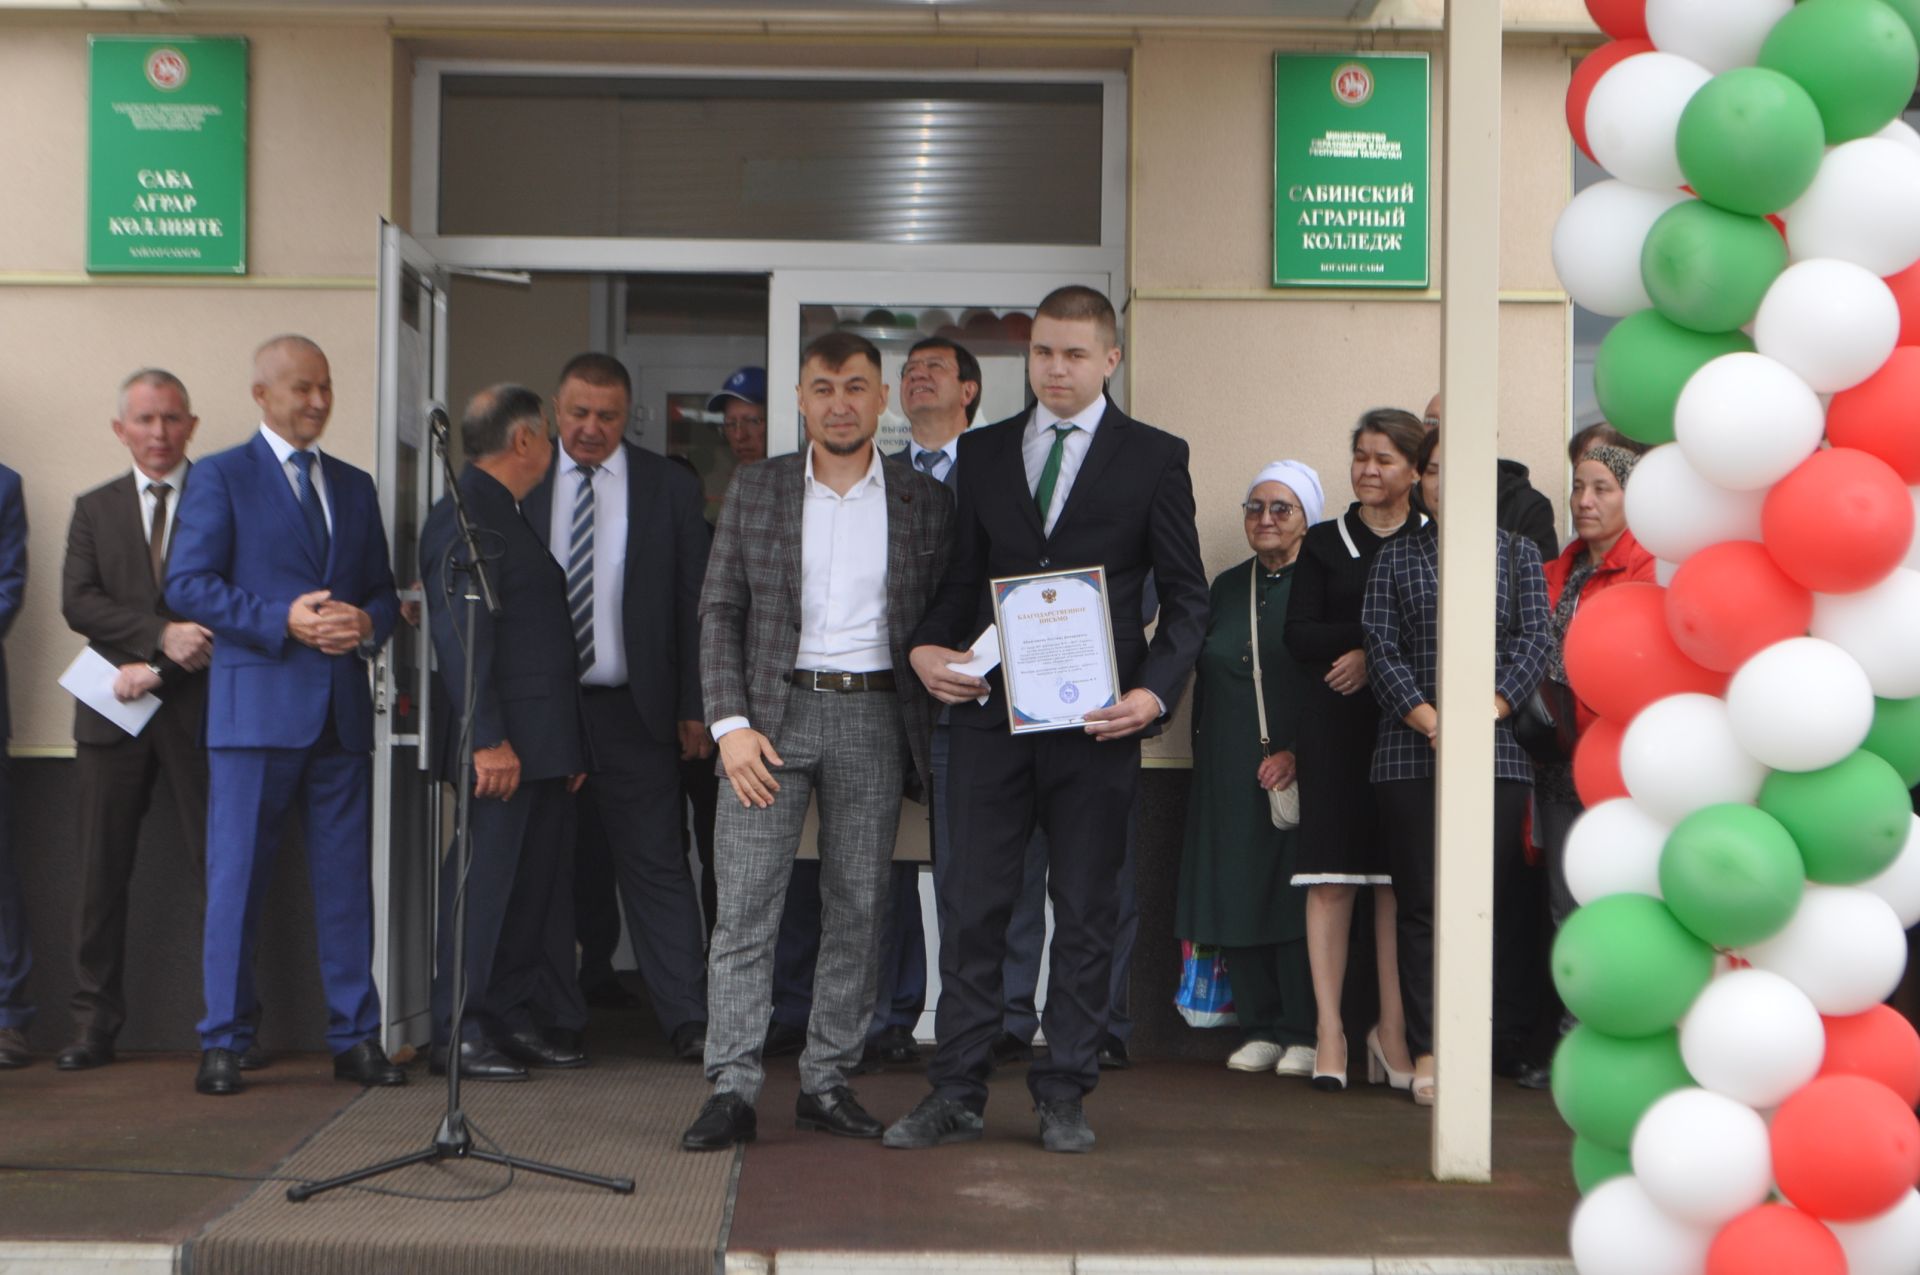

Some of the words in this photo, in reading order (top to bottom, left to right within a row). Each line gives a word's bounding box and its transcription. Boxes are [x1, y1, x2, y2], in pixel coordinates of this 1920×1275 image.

[137, 169, 194, 189] САБА
[1288, 182, 1414, 203] САБИНСКИЙ
[132, 193, 197, 213] АГРАР
[1298, 206, 1406, 227] АГРАРНЫЙ
[1302, 231, 1403, 253] КОЛЛЕДЖ
[1320, 263, 1358, 273] БОГАТЫЕ
[1360, 264, 1385, 273] САБЫ
[1039, 615, 1069, 625] ПИСЬМО
